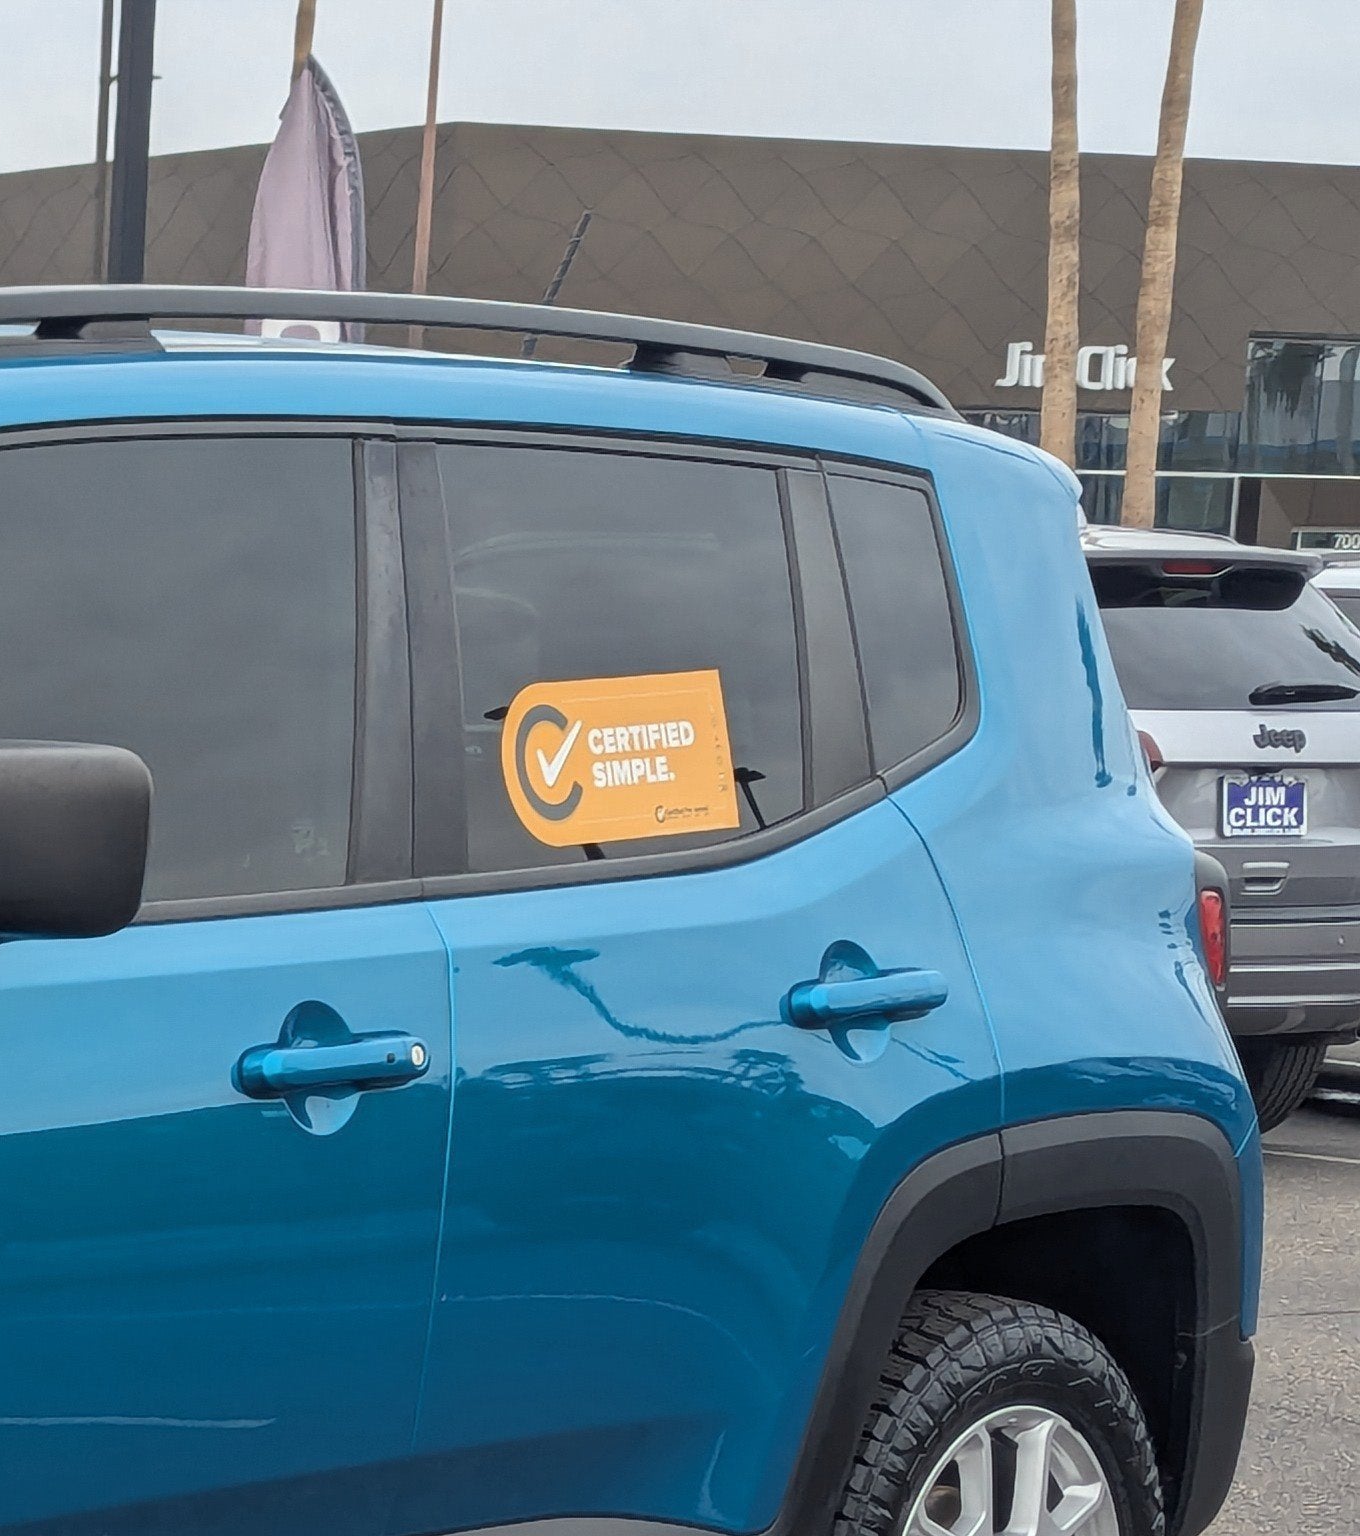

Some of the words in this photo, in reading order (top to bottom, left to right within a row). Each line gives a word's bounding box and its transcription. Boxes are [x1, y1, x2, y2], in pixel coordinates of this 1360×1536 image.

[587, 720, 695, 755] CERTIFIED
[1253, 724, 1307, 753] Jeep
[591, 756, 676, 788] SIMPLE.
[1244, 787, 1286, 806] JIM
[1229, 807, 1298, 827] CLICK
